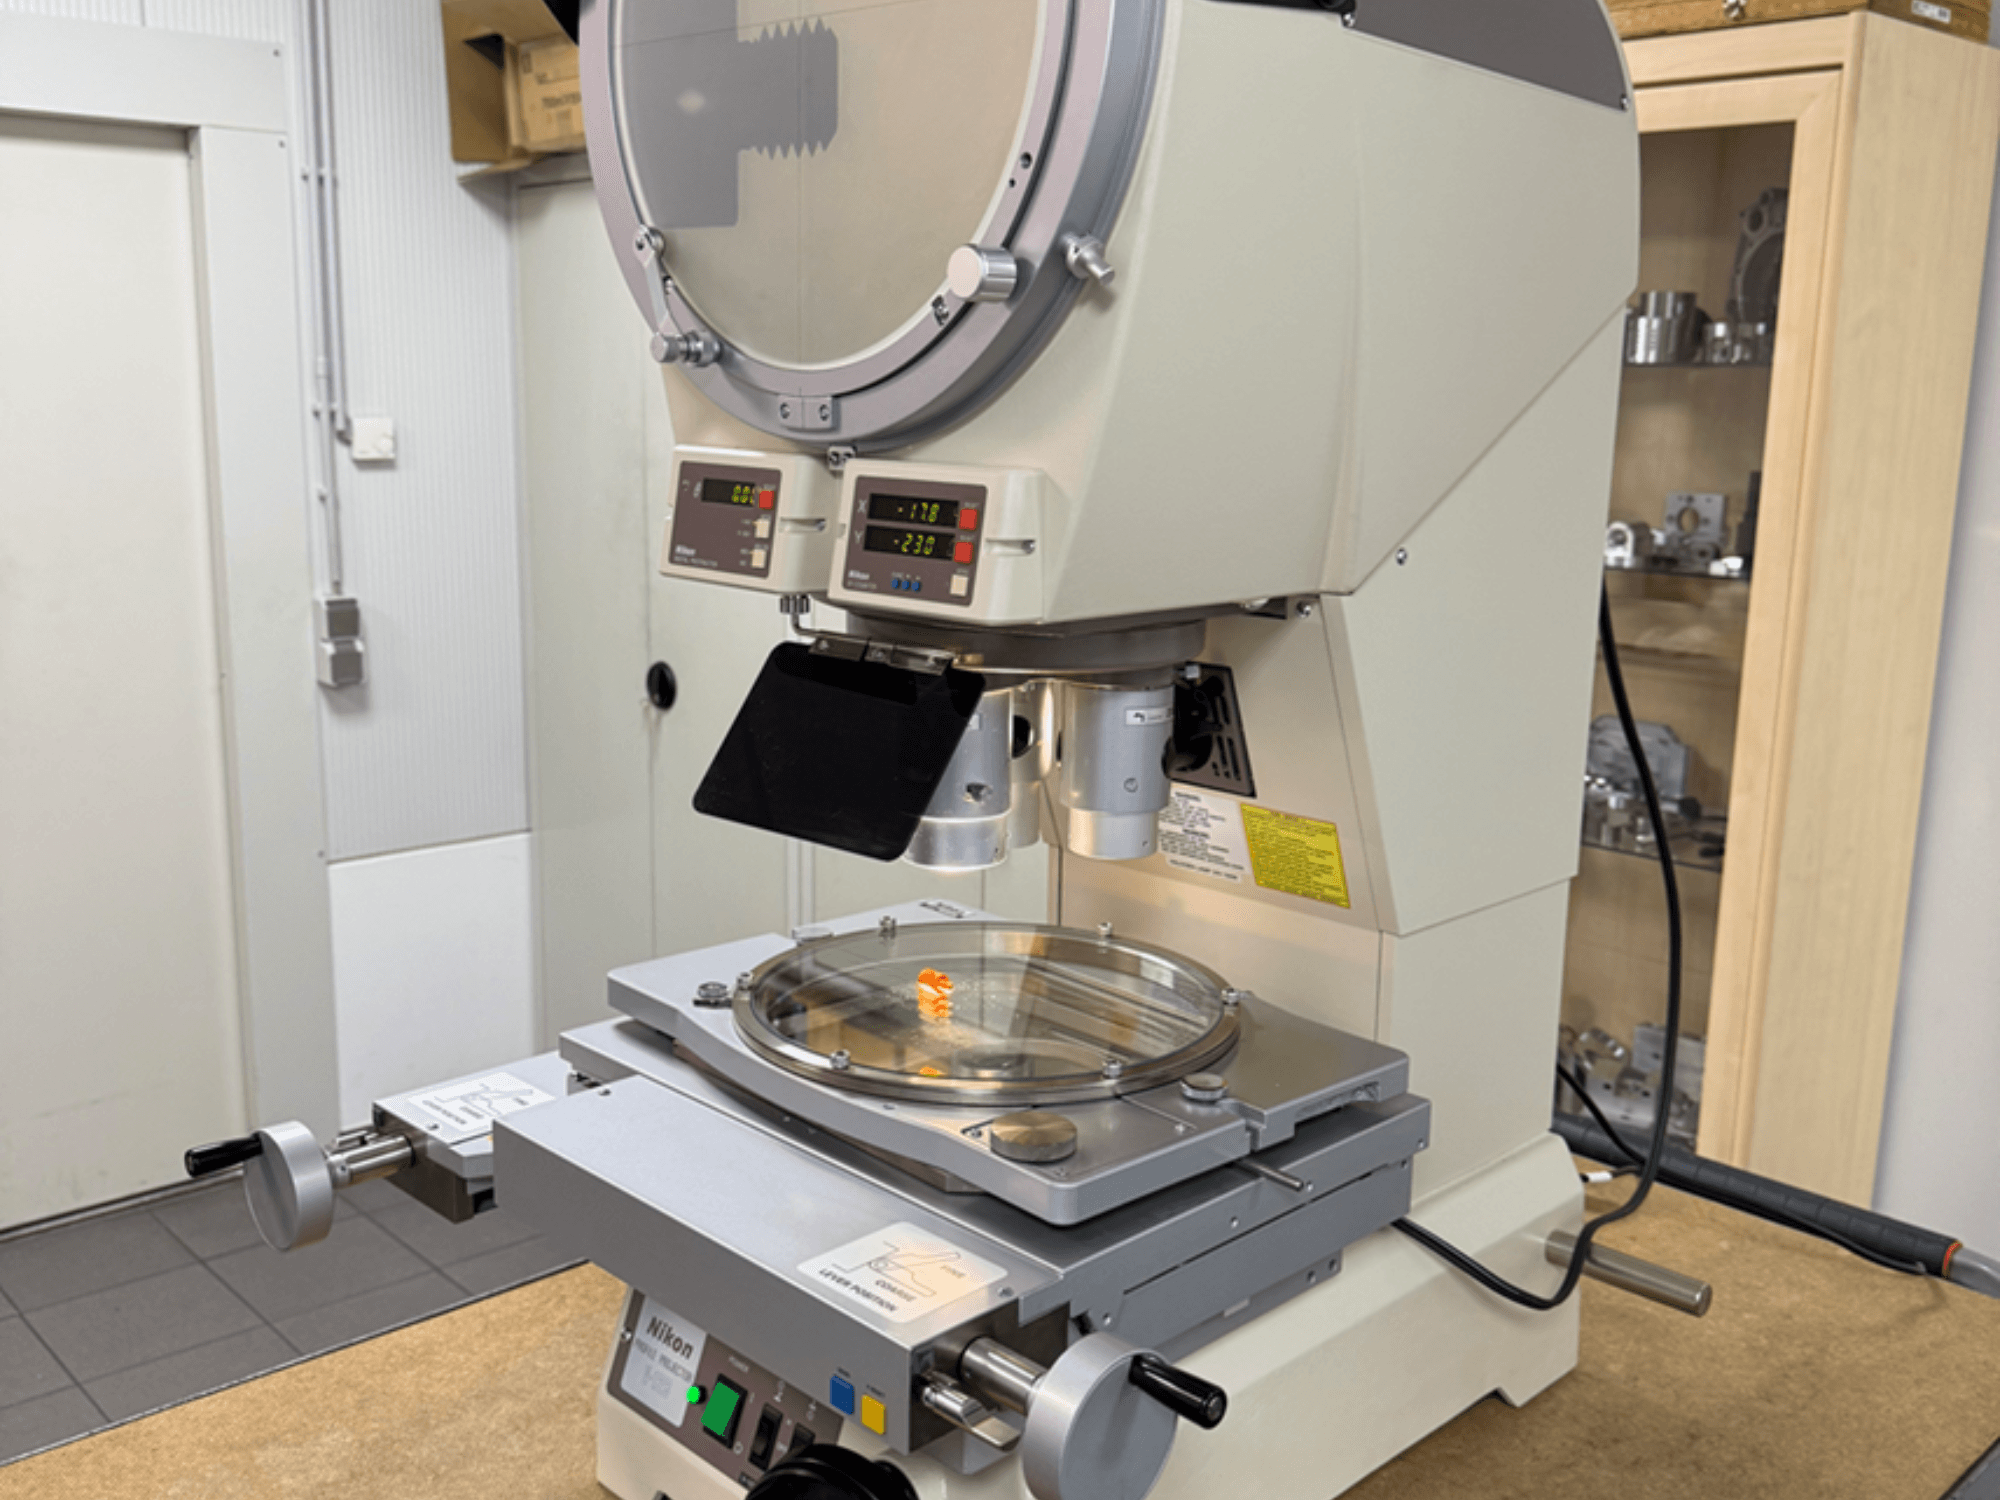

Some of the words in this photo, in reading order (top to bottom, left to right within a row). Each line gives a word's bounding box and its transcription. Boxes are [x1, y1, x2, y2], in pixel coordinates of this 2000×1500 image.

[857, 499, 867, 513] X
[854, 530, 864, 544] Y
[819, 1268, 851, 1287] LEVER
[851, 1284, 897, 1312] POSITION
[646, 1316, 694, 1360] Nikon
